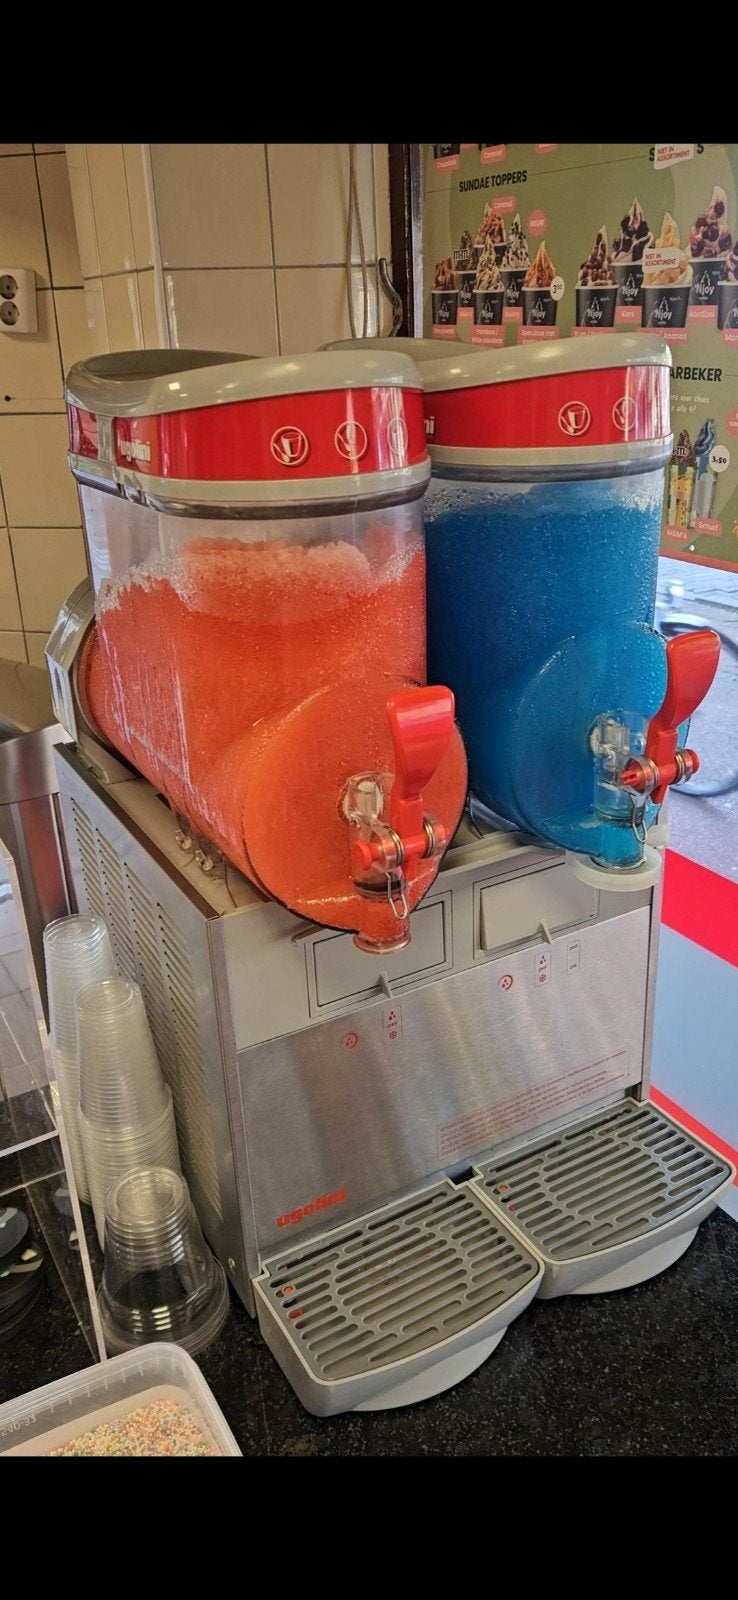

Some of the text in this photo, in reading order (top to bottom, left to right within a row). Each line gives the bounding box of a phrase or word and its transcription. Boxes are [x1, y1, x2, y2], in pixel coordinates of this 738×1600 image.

[459, 170, 528, 192] SUNDAE TOPPERS
[688, 310, 715, 318] Aardbei
[663, 333, 687, 341] Ananas
[698, 521, 719, 532] Smurf
[276, 1188, 346, 1228] ugolini
